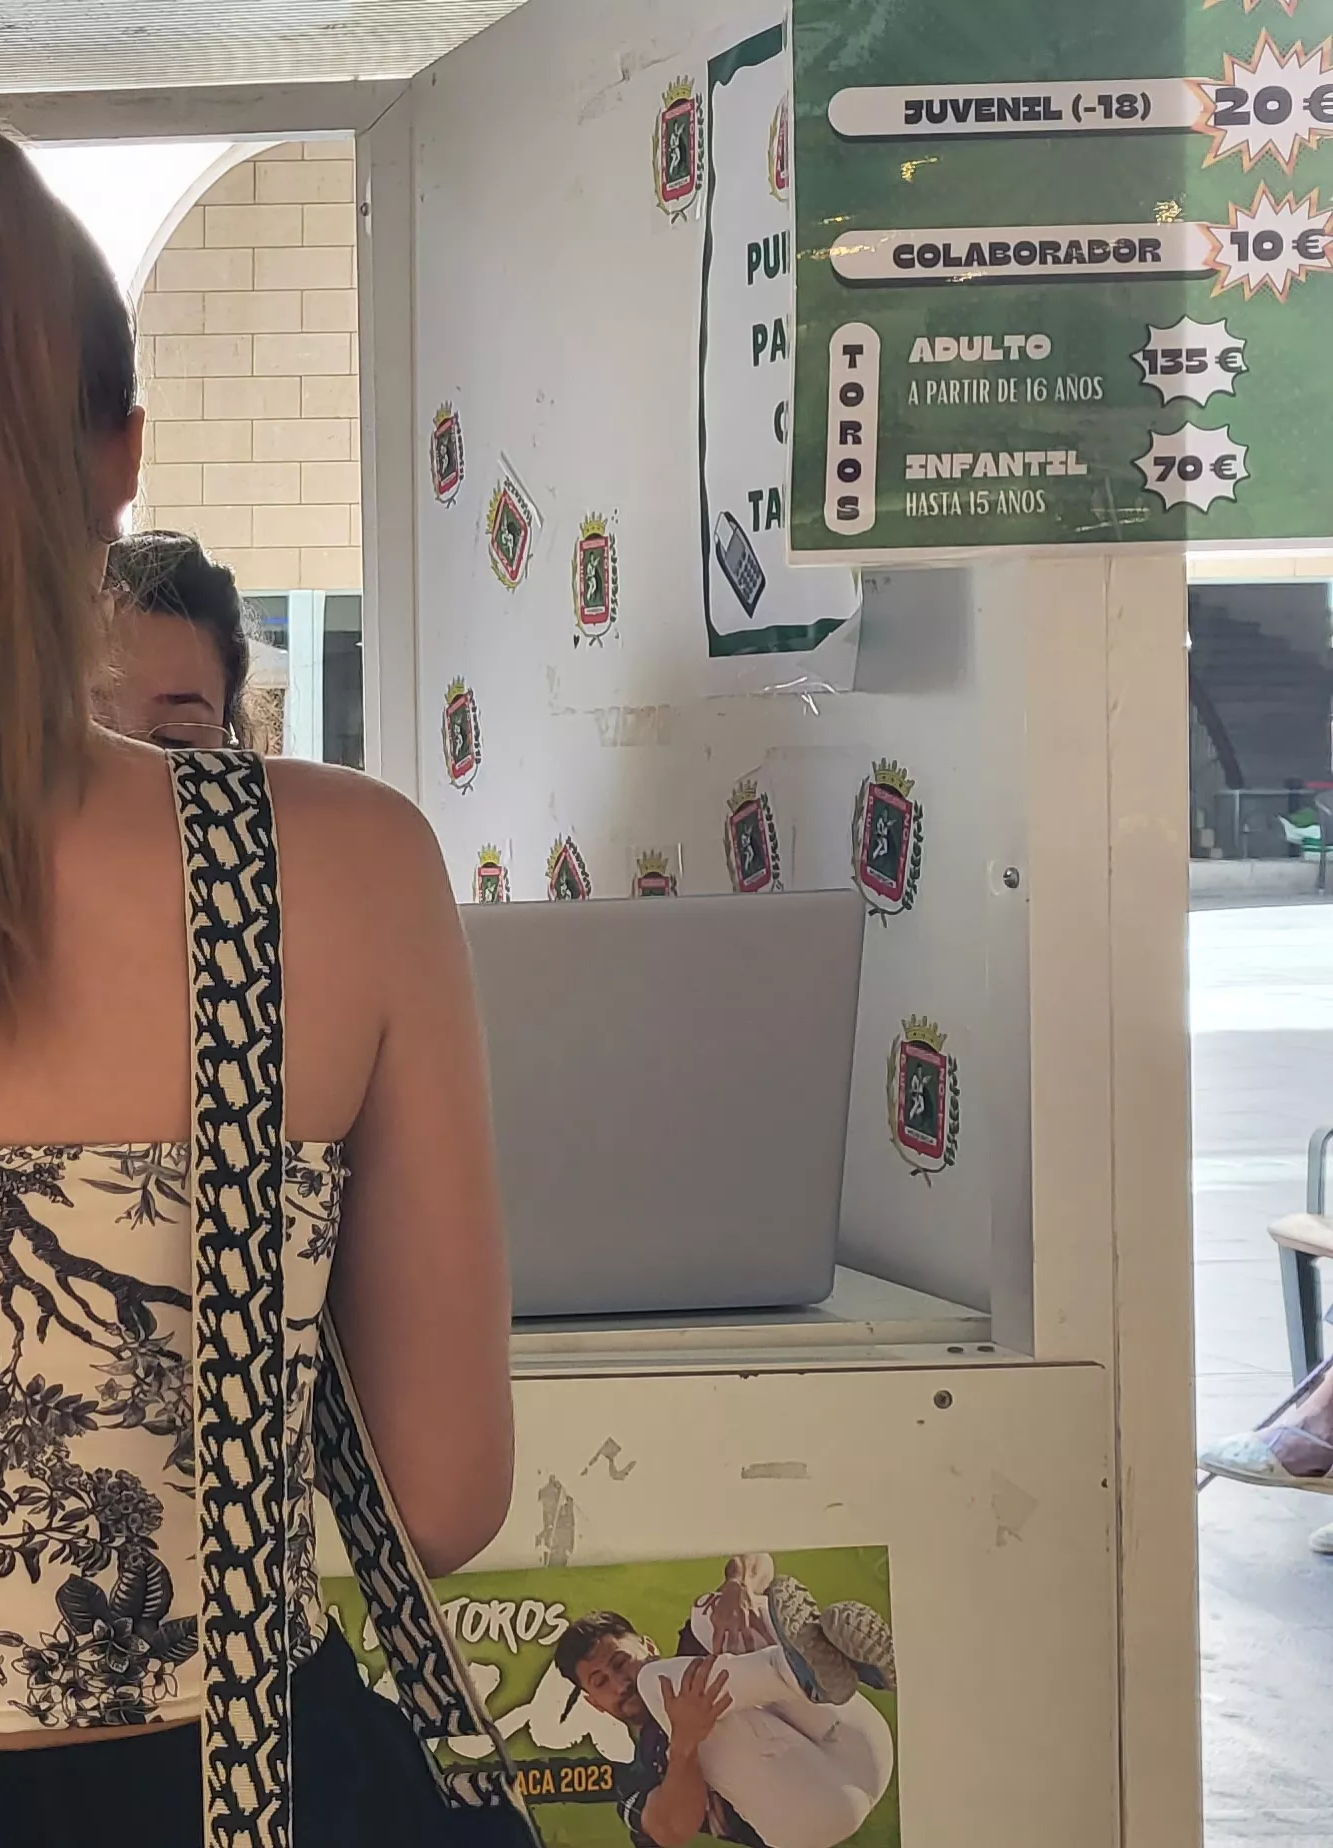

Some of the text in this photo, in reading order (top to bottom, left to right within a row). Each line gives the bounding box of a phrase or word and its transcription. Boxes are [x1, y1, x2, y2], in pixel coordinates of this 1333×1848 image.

[904, 85, 1333, 126] JUVENIL (-18) 20 €
[892, 228, 1327, 269] COLABORADOR 10 €
[908, 334, 1244, 376] ADULTO 135 €
[909, 381, 919, 406] A
[926, 377, 990, 405] PARTIR
[998, 377, 1018, 403] DE
[1026, 377, 1047, 402] 16
[836, 344, 865, 521] TOROS
[905, 450, 1238, 483] INFANTIL 70 €
[905, 490, 962, 517] HASTA
[969, 489, 990, 515] 15
[441, 1596, 571, 1655] TOROS
[560, 1764, 614, 1793] 2023
